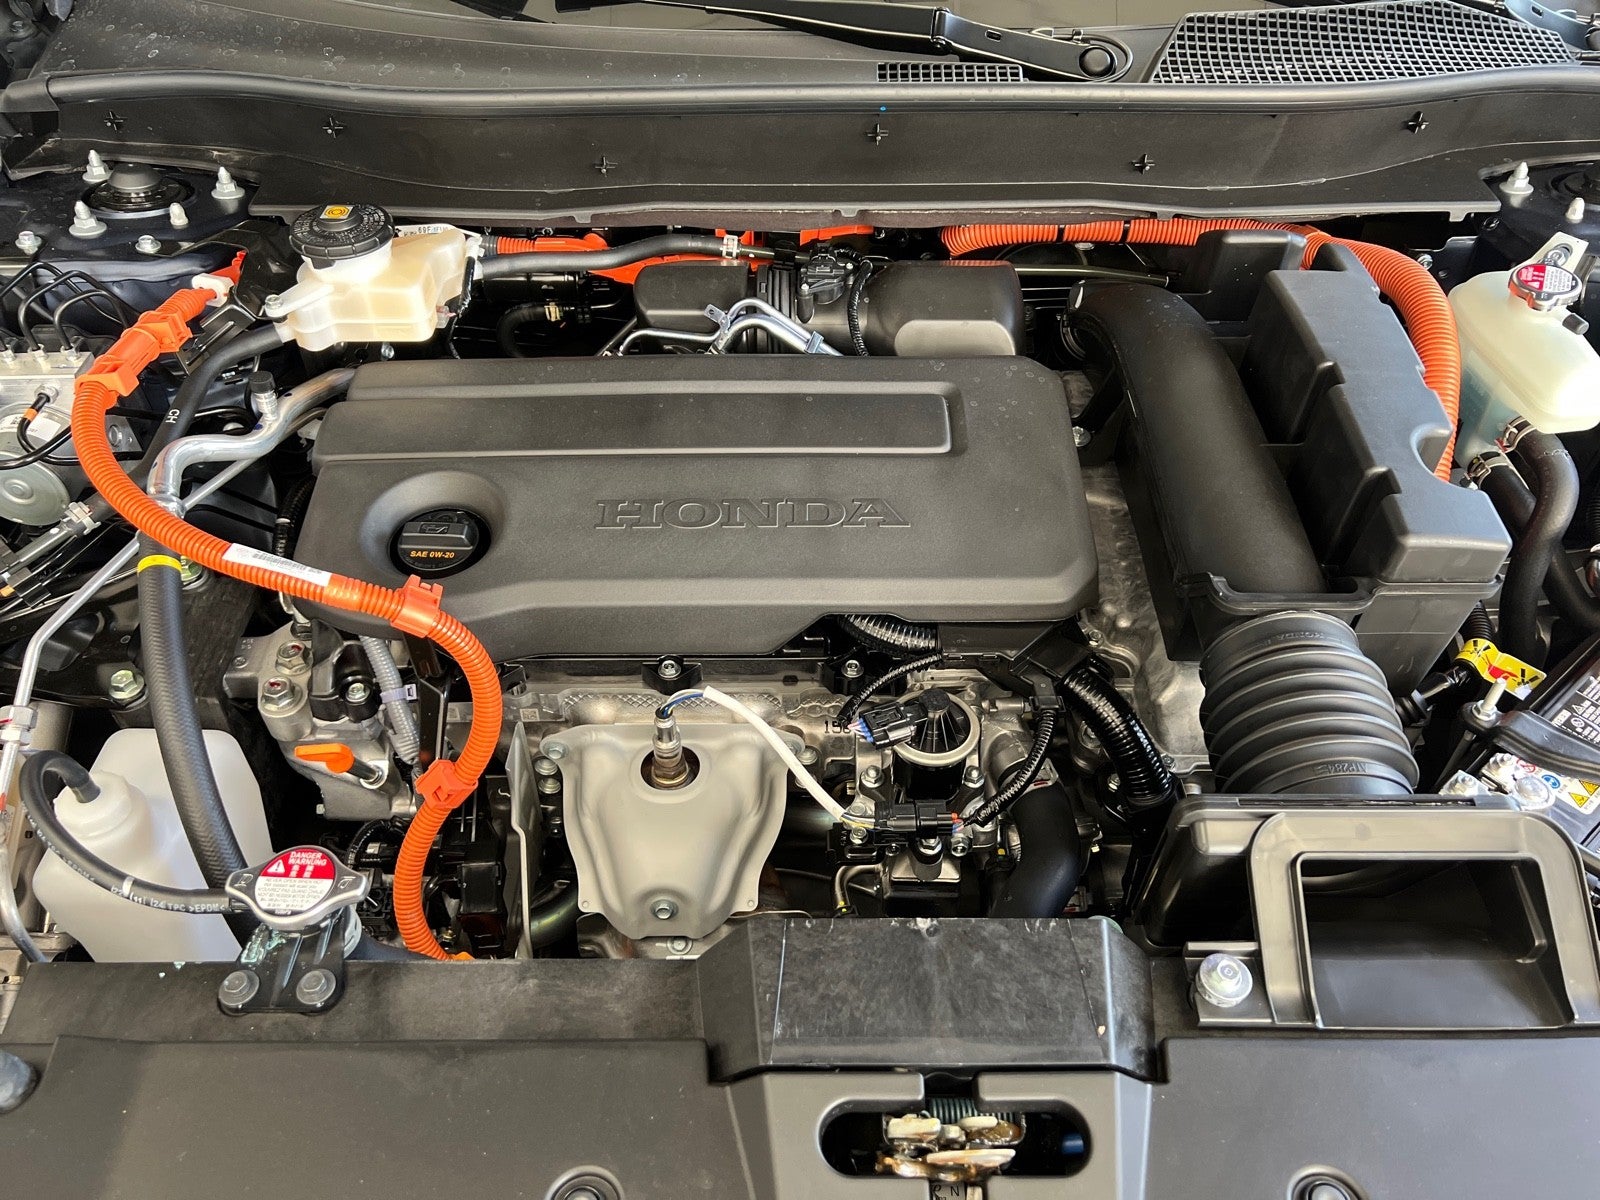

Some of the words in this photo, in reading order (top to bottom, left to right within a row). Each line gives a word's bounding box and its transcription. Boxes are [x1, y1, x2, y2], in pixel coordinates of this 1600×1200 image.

[164, 409, 180, 424] CH
[595, 497, 911, 529] HONDA
[410, 550, 428, 558] SAE
[429, 551, 455, 559] 0W-20
[290, 851, 323, 859] DANGER
[288, 858, 327, 866] WARNUNG
[168, 903, 185, 911] TPC
